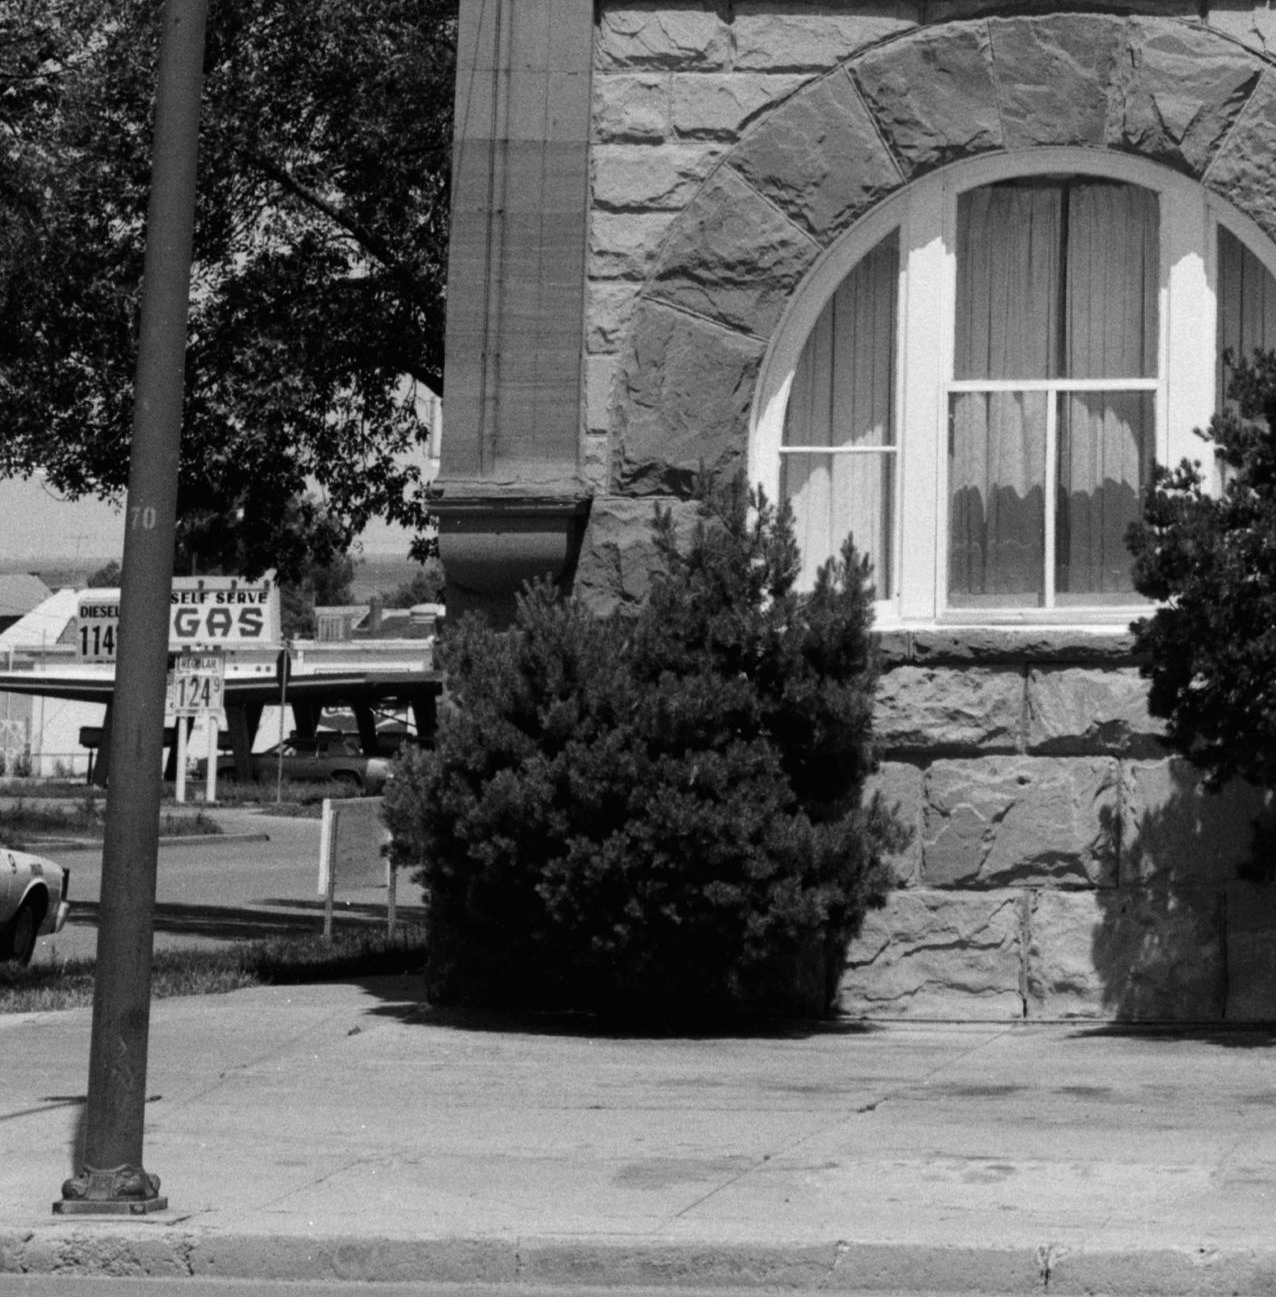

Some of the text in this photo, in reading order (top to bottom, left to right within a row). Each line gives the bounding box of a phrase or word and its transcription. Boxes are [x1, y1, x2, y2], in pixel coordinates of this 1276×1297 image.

[130, 506, 157, 531] 70
[170, 592, 269, 605] SELF SERVE
[80, 605, 121, 619] DIESEL
[174, 608, 265, 638] GAS
